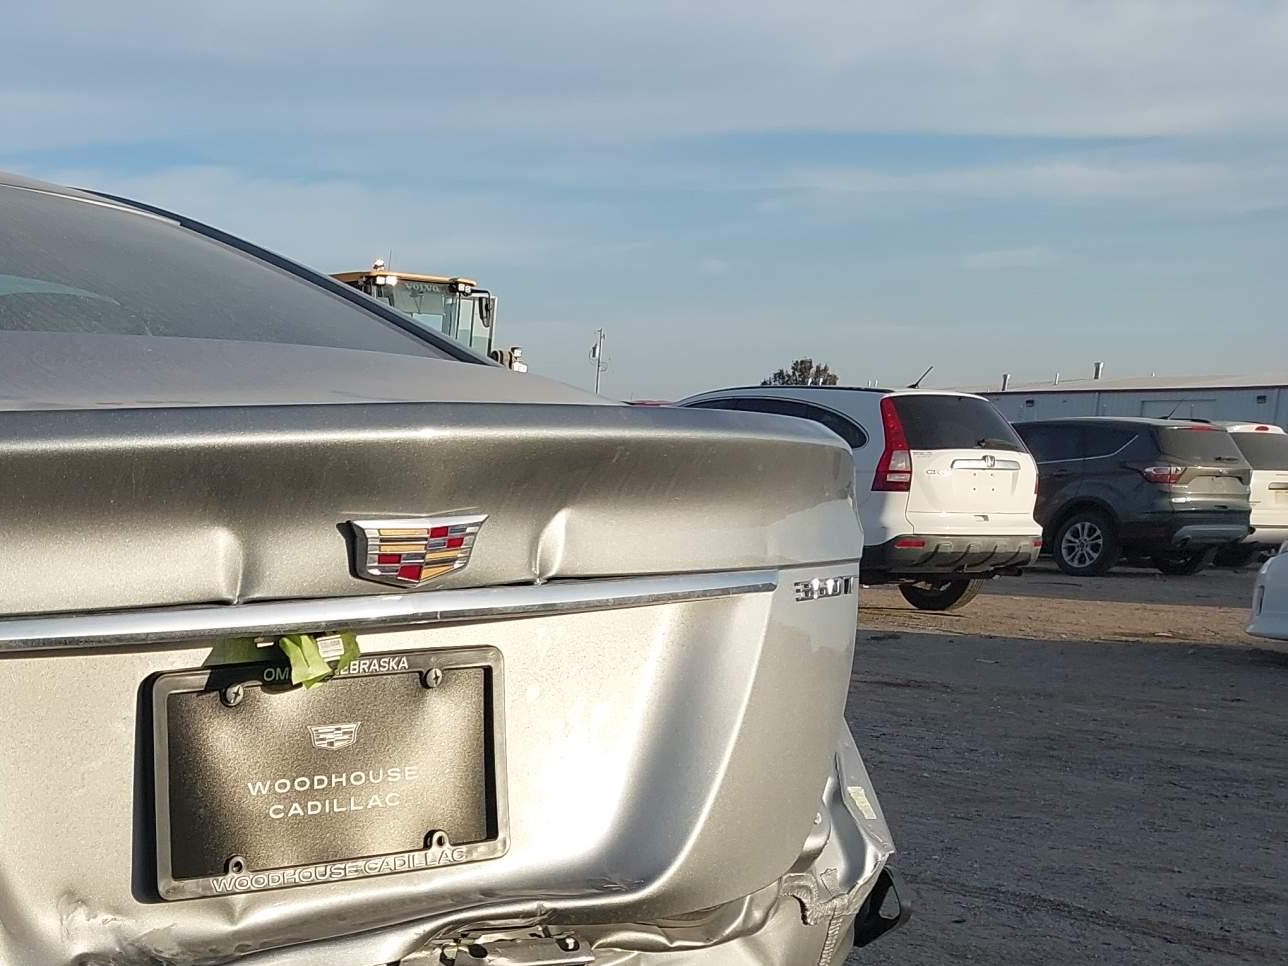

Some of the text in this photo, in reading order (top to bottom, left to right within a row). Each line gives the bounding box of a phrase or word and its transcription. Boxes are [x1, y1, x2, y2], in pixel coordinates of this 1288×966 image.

[263, 667, 290, 683] OM
[247, 766, 419, 796] WOODHOUSE
[269, 793, 401, 819] CADILLAC
[211, 849, 467, 893] WOODHOUSE CADILLAC
